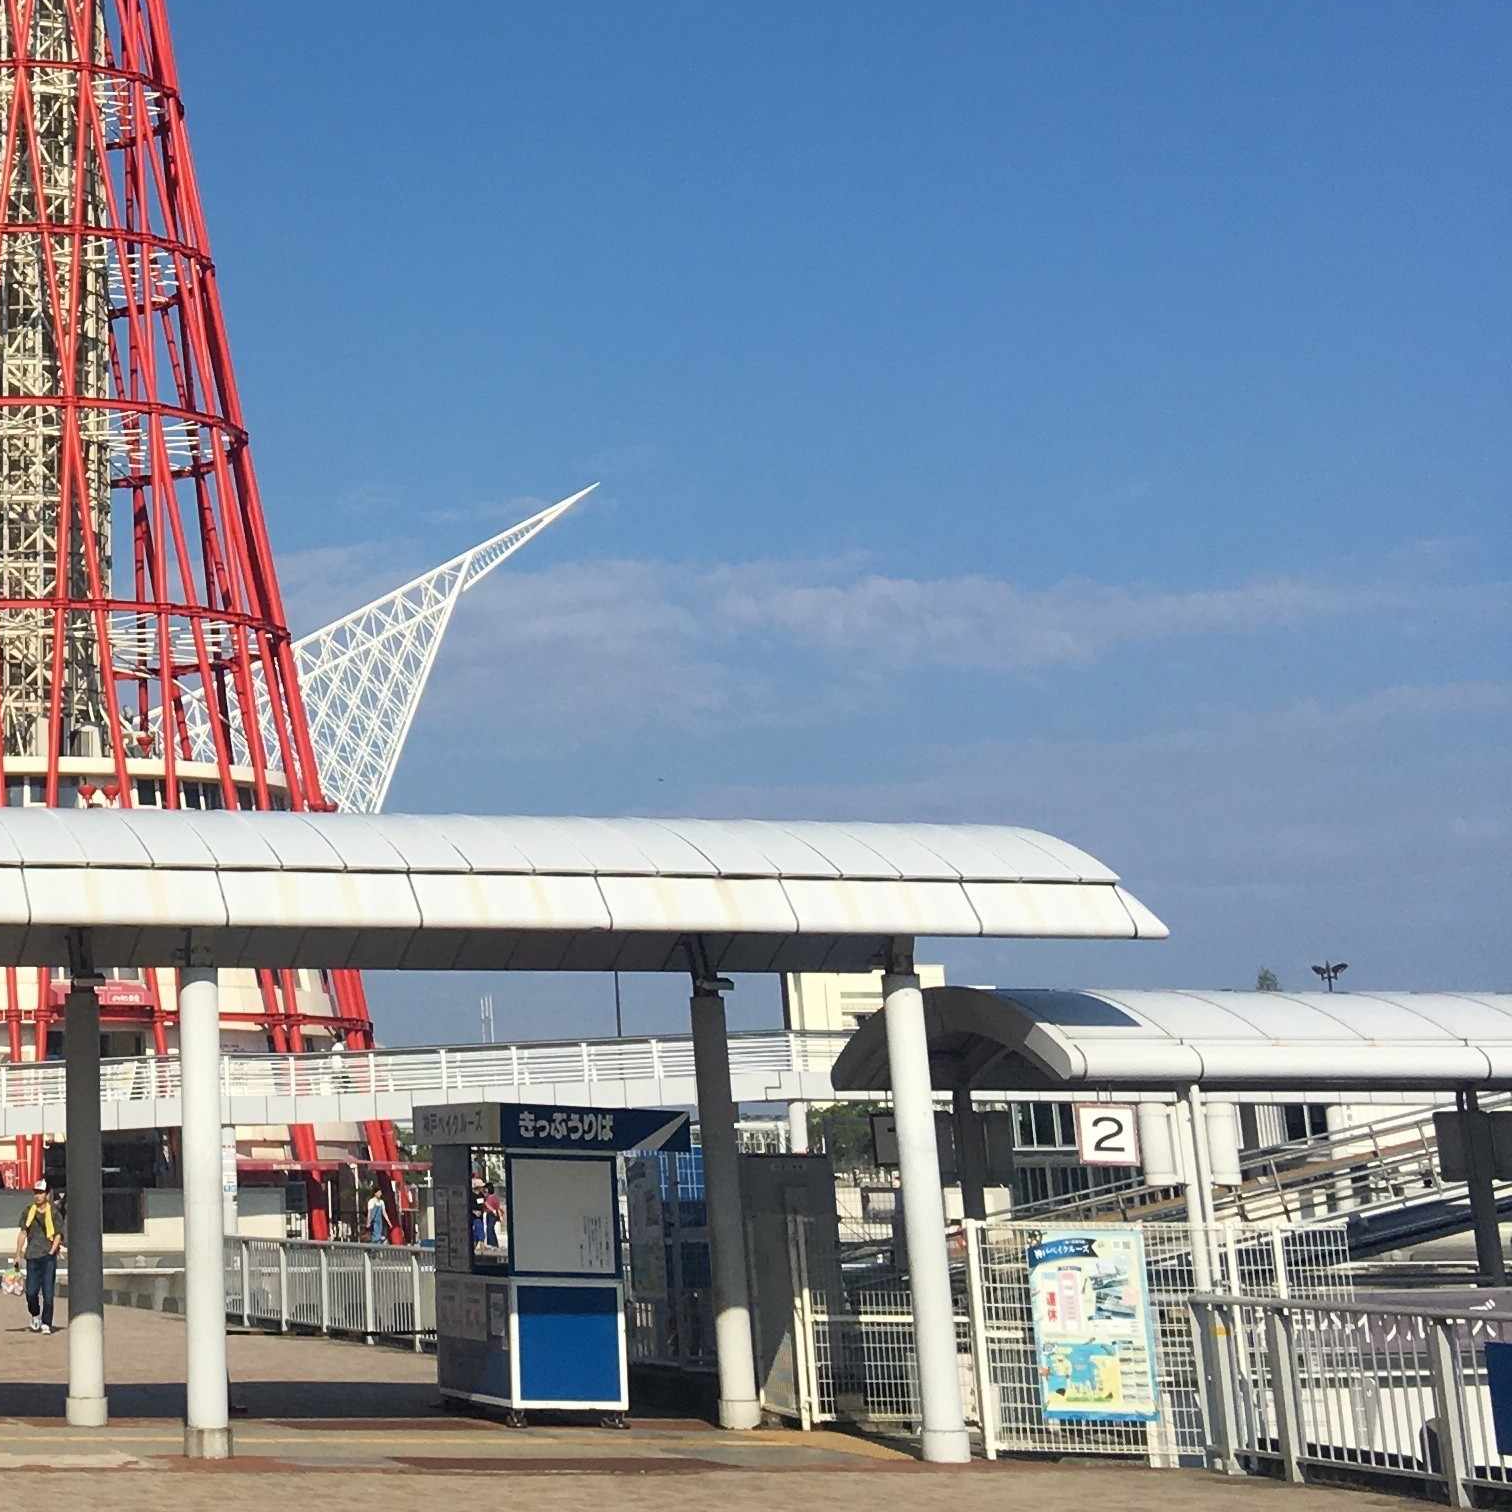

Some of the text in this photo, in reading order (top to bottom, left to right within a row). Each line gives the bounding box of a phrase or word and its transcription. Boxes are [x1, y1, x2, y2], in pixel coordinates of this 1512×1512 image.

[519, 1110, 614, 1141] きっぷうりば
[1091, 1116, 1126, 1153] 2
